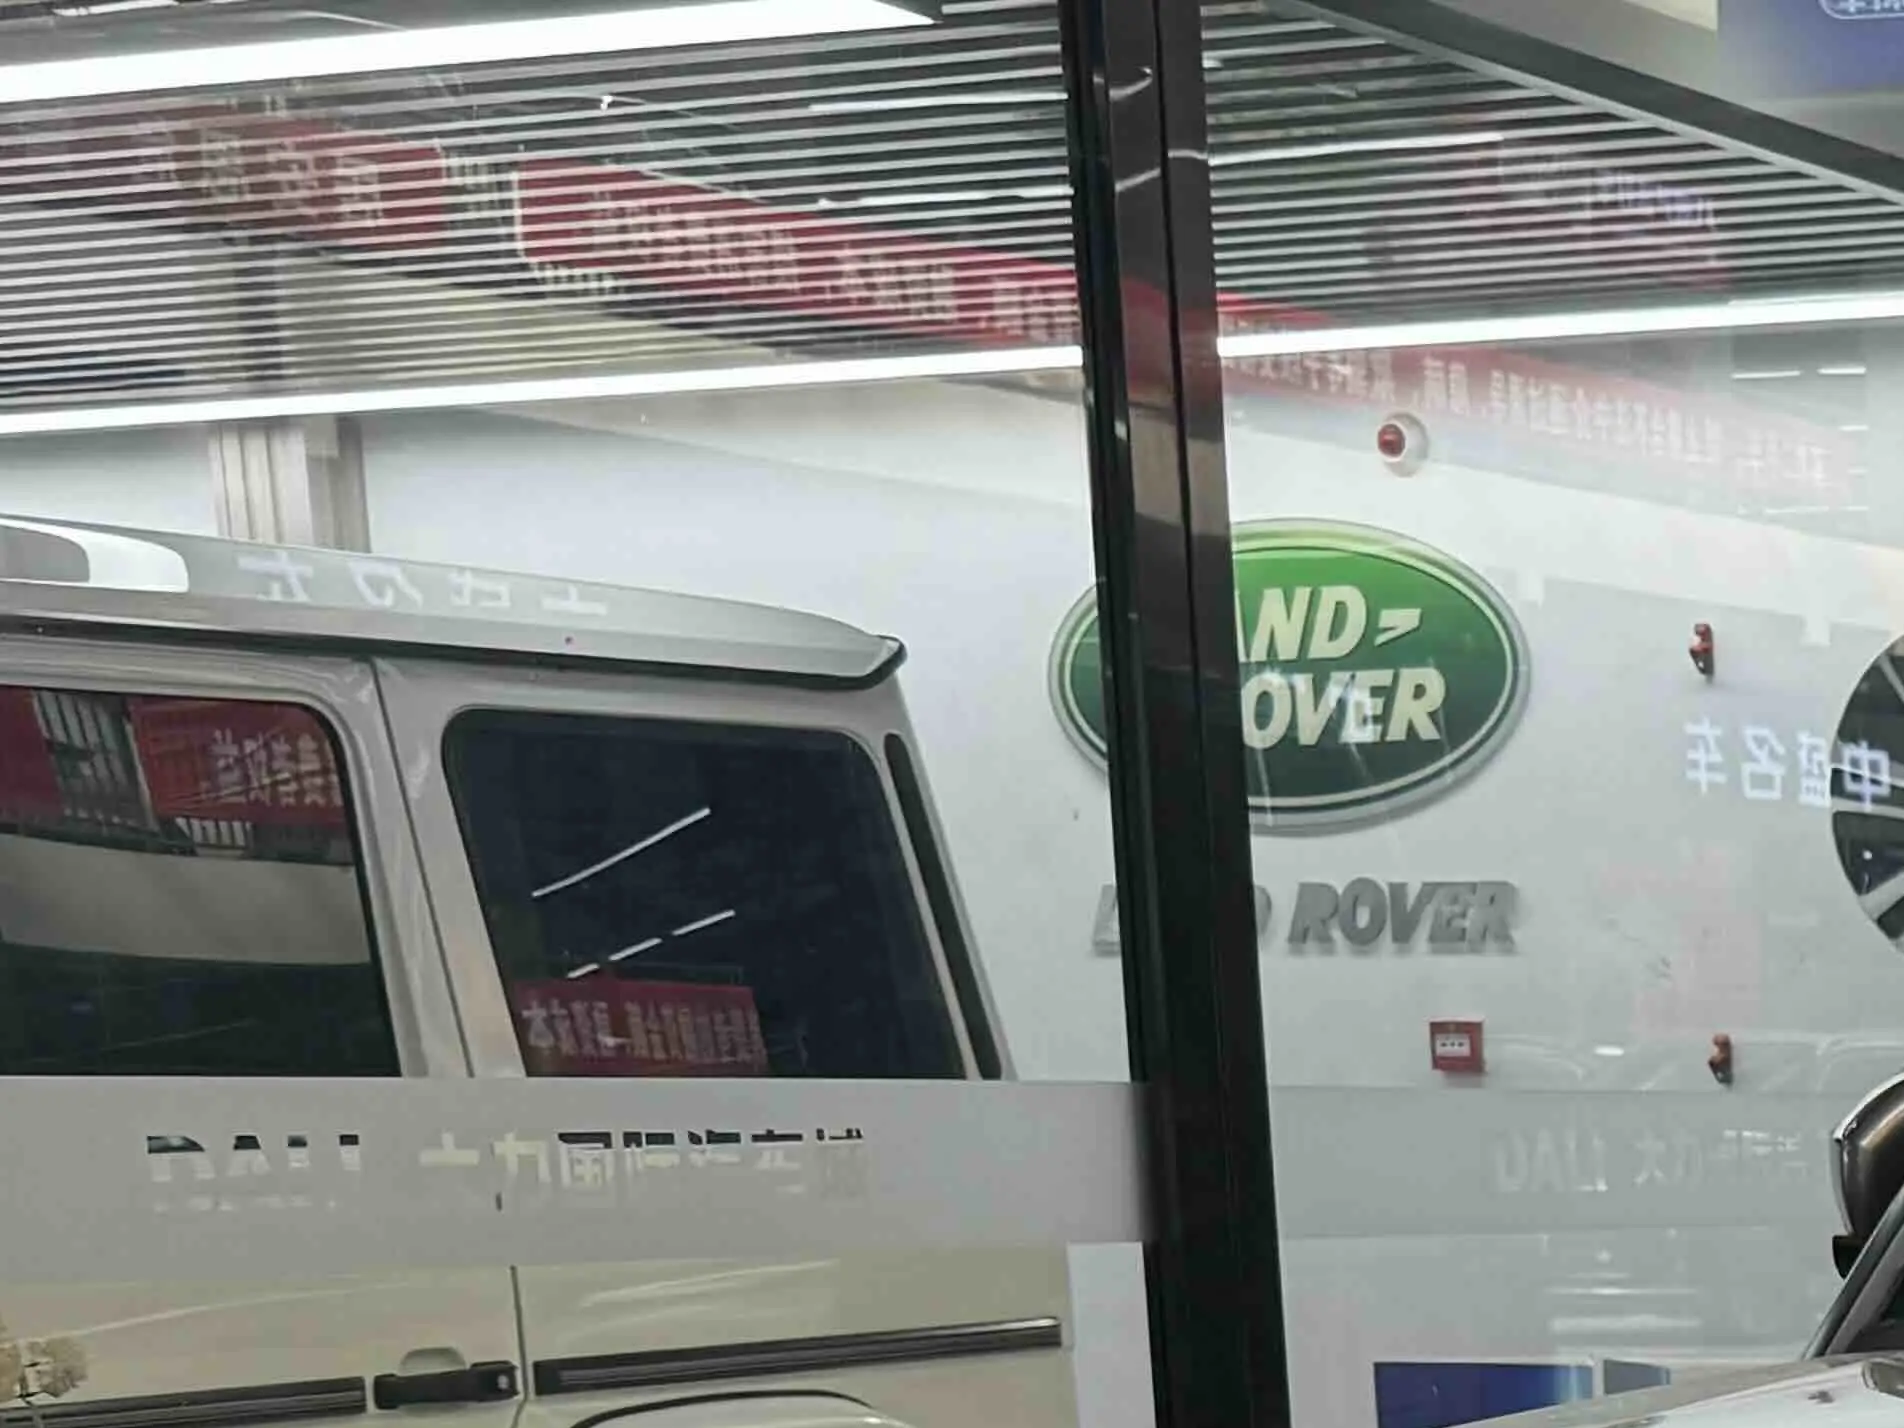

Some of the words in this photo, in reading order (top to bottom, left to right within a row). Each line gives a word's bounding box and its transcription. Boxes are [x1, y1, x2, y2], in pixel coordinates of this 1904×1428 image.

[1236, 586, 1367, 662] ND
[1241, 667, 1446, 749] OVER
[1287, 877, 1518, 947] ROVER
